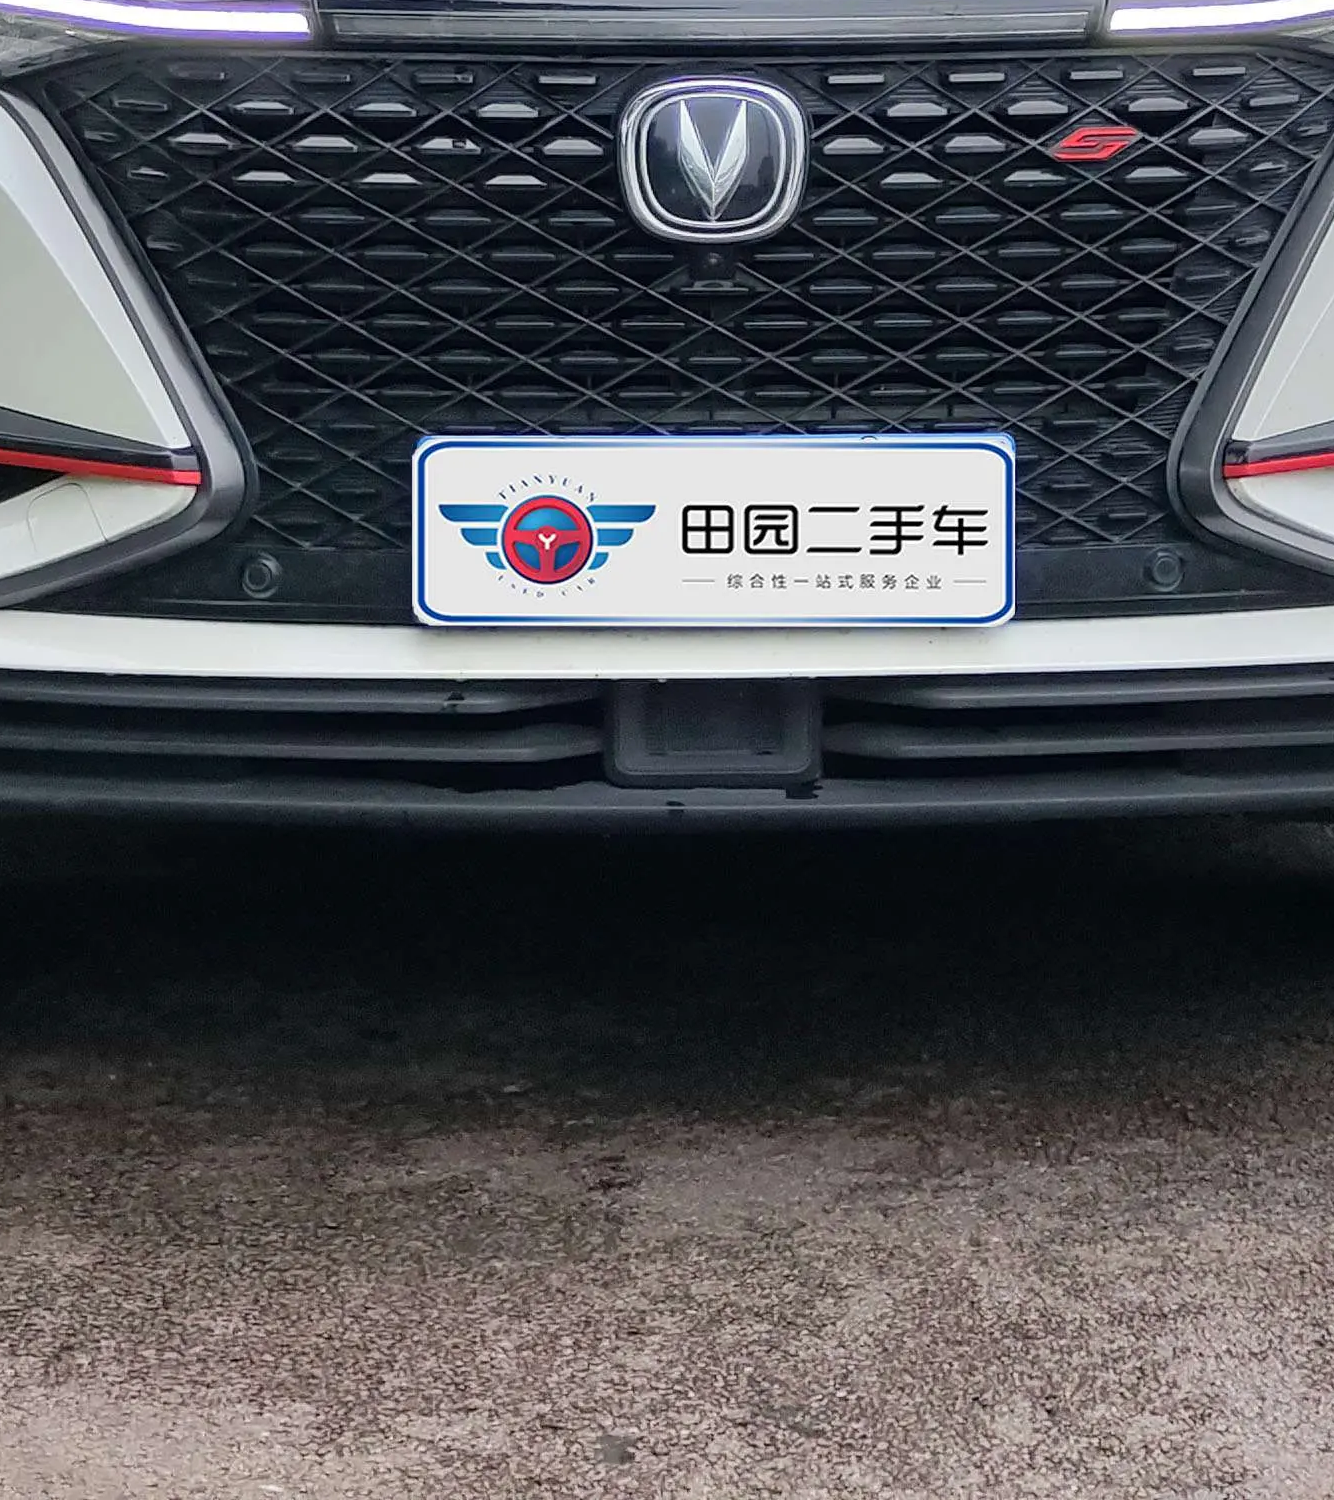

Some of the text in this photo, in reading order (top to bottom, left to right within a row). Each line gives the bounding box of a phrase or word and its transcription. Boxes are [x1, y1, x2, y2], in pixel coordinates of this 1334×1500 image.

[682, 504, 989, 555] 田园二手车
[726, 573, 943, 591] 综合性一站式服务企业
